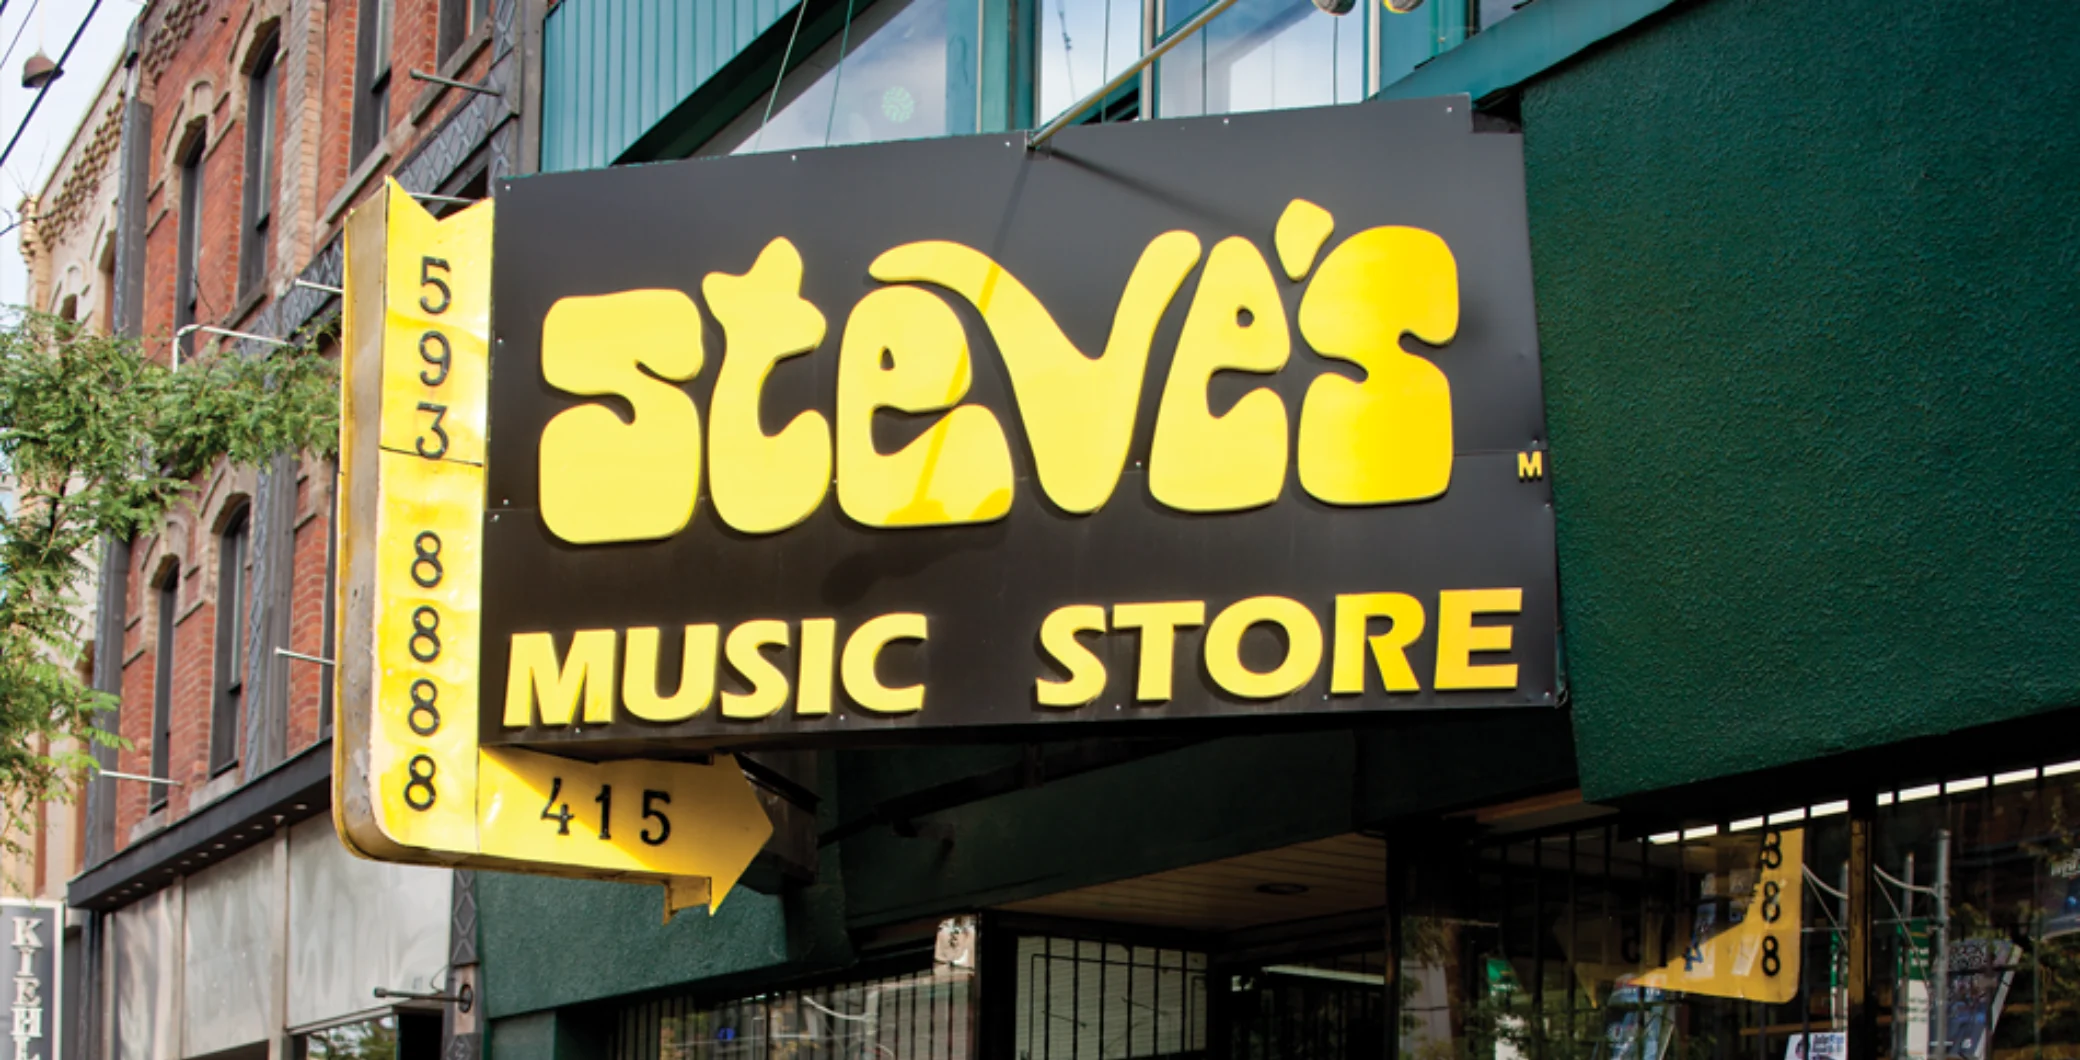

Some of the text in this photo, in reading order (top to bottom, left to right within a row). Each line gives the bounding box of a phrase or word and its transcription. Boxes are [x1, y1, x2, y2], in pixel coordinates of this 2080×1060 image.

[1517, 450, 1543, 479] M
[503, 587, 1523, 727] MUSIC STORE
[541, 777, 673, 847] 415
